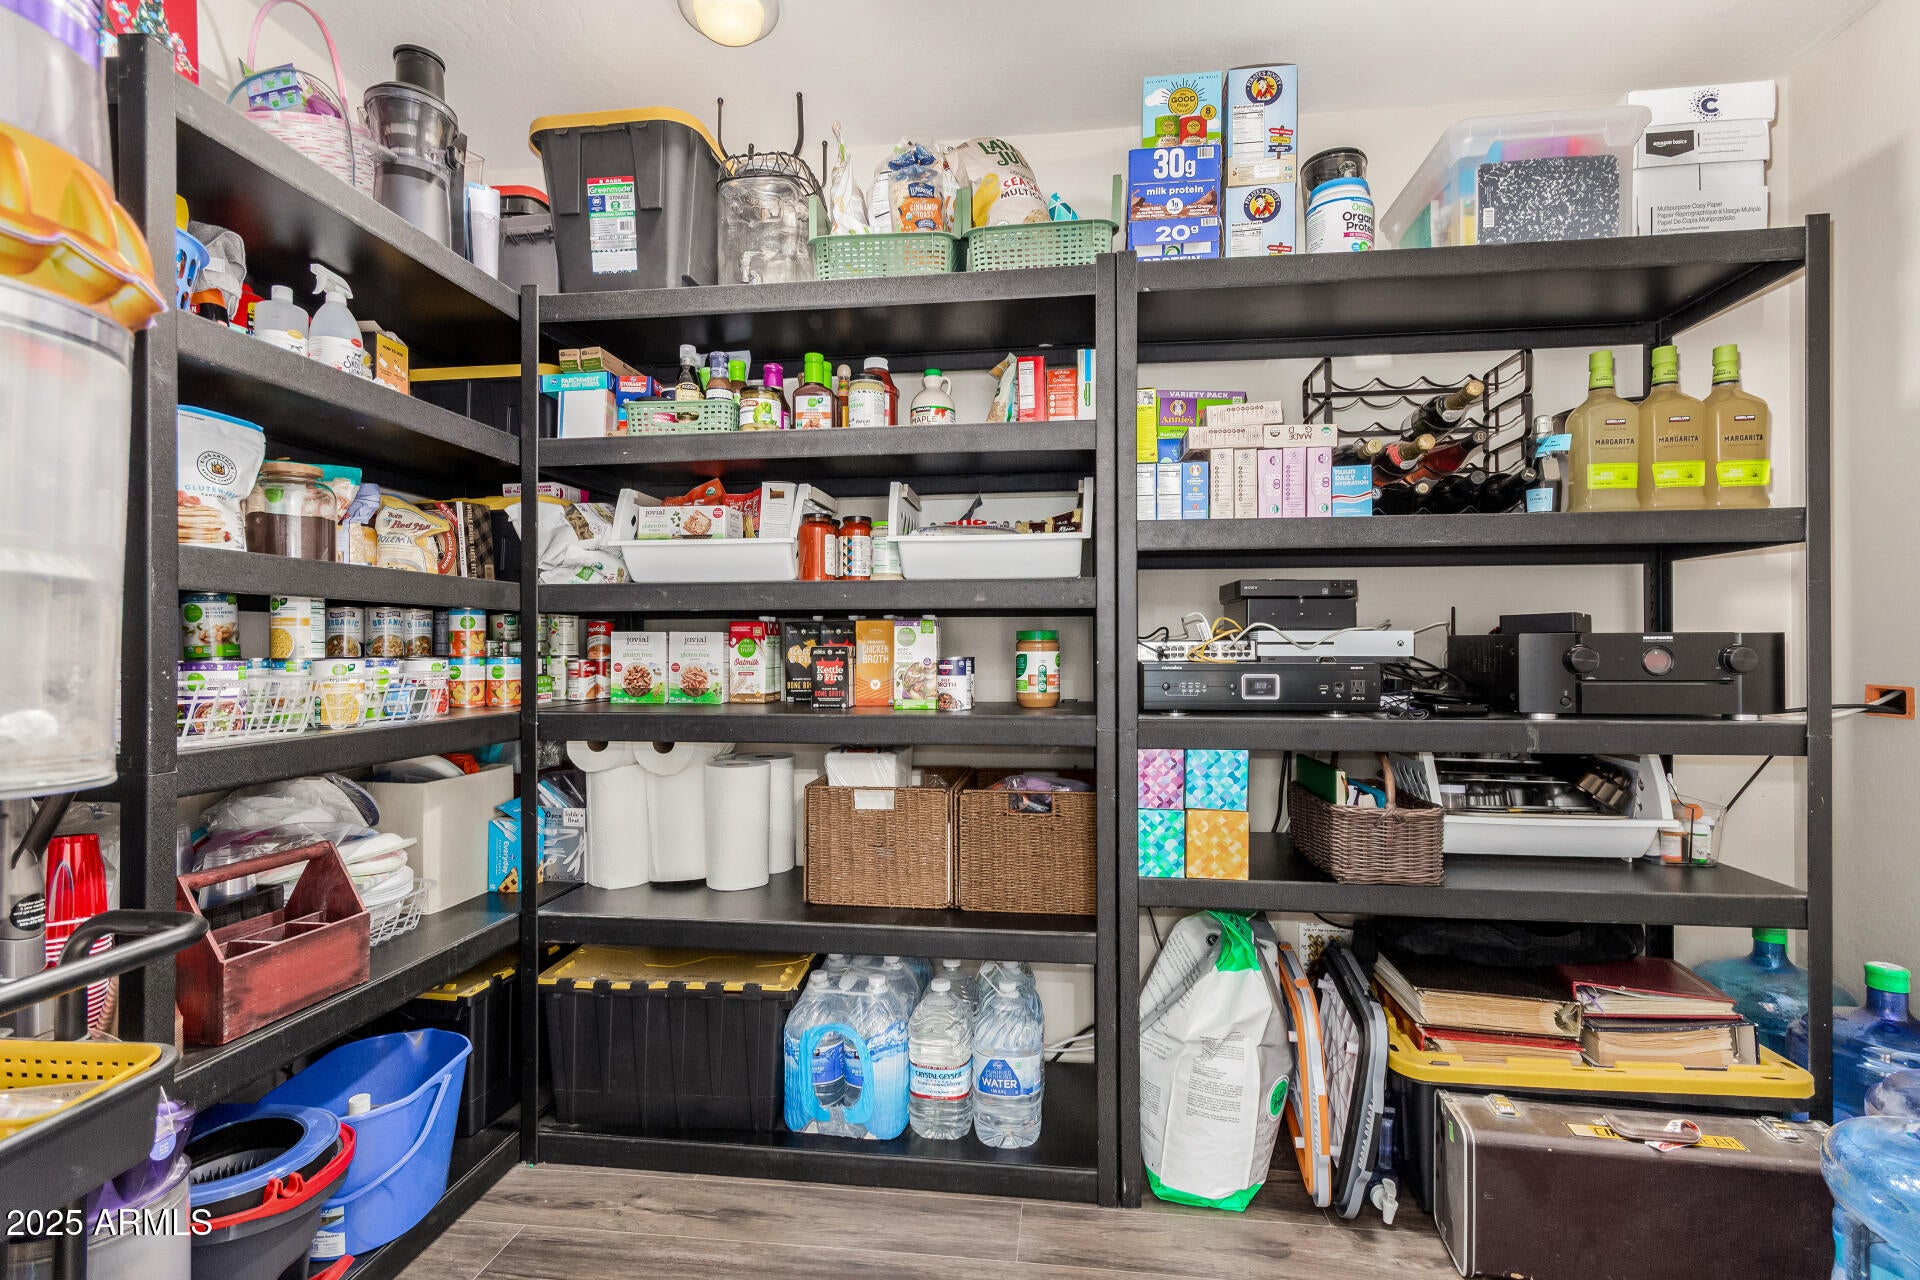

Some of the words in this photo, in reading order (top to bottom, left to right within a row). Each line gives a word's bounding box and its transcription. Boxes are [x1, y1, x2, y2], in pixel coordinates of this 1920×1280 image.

[1171, 96, 1196, 104] GOOD
[1205, 106, 1211, 114] 8
[1701, 97, 1720, 114] C
[1153, 147, 1196, 179] 30g
[1146, 187, 1167, 196] milk
[1168, 185, 1204, 196] protein
[909, 203, 938, 212] CINNAMON
[1657, 203, 1691, 212] Multipurpose
[1706, 201, 1723, 209] Paper
[1723, 207, 1741, 216] Usage
[1155, 224, 1199, 242] 20g
[561, 376, 600, 384] PARCHMENT
[912, 415, 937, 424] MAPLE
[1161, 415, 1194, 424] Annie's
[1594, 438, 1635, 446] MARGARITA
[1658, 435, 1699, 443] MARGARITA
[1724, 434, 1764, 442] MARGARITA
[466, 504, 474, 522] WHOLE
[645, 509, 665, 517] jovial
[390, 520, 412, 530] Red
[412, 522, 432, 531] Mill
[441, 551, 453, 570] GRAINS
[626, 636, 649, 645] jovial
[684, 636, 707, 645] jovial
[862, 644, 890, 653] CHICKEN
[733, 658, 760, 667] Oatmilk
[862, 655, 889, 664] BROTH
[816, 666, 844, 674] Kettle
[502, 840, 514, 874] Everyday
[915, 1071, 938, 1080] CRYSTAL
[938, 1071, 962, 1080] GEYSER
[981, 1077, 1018, 1089] WATER
